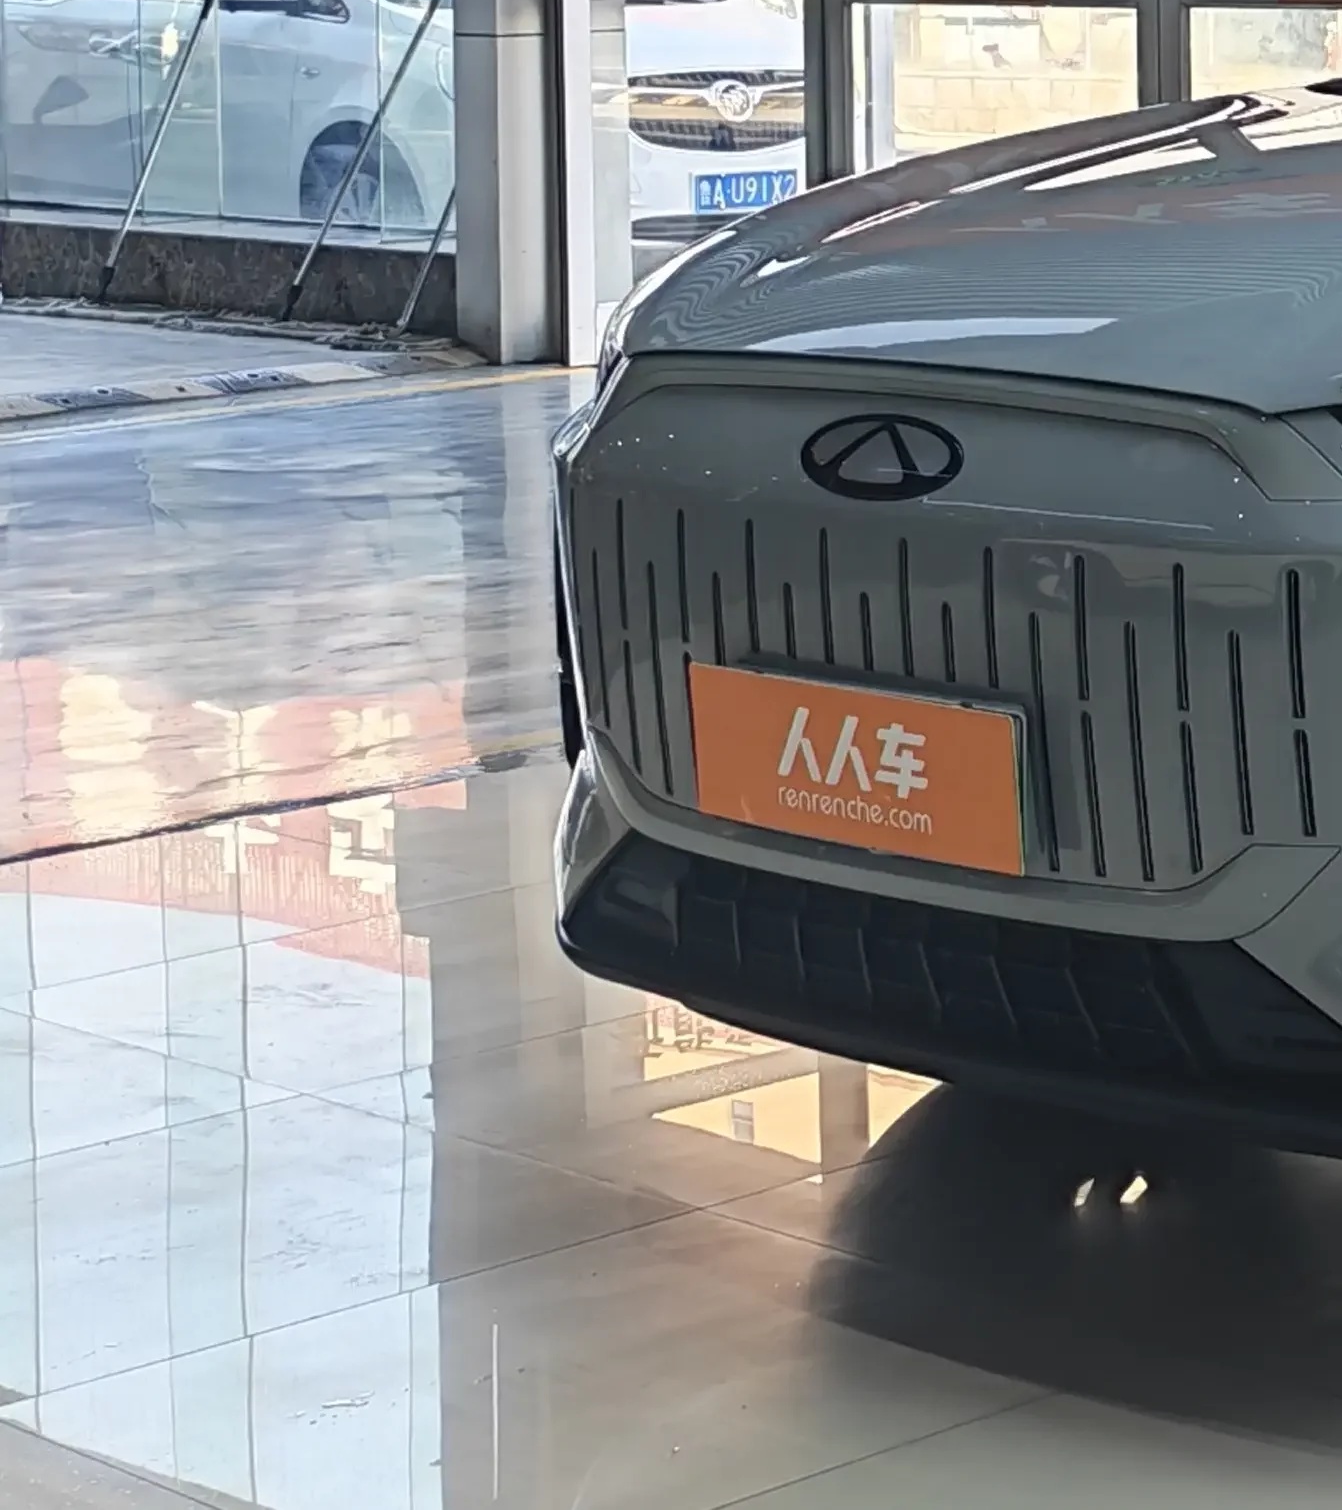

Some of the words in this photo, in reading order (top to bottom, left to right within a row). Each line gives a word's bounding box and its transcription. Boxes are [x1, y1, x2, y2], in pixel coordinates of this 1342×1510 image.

[777, 706, 929, 799] 人人车
[778, 786, 933, 836] renrenche.com
